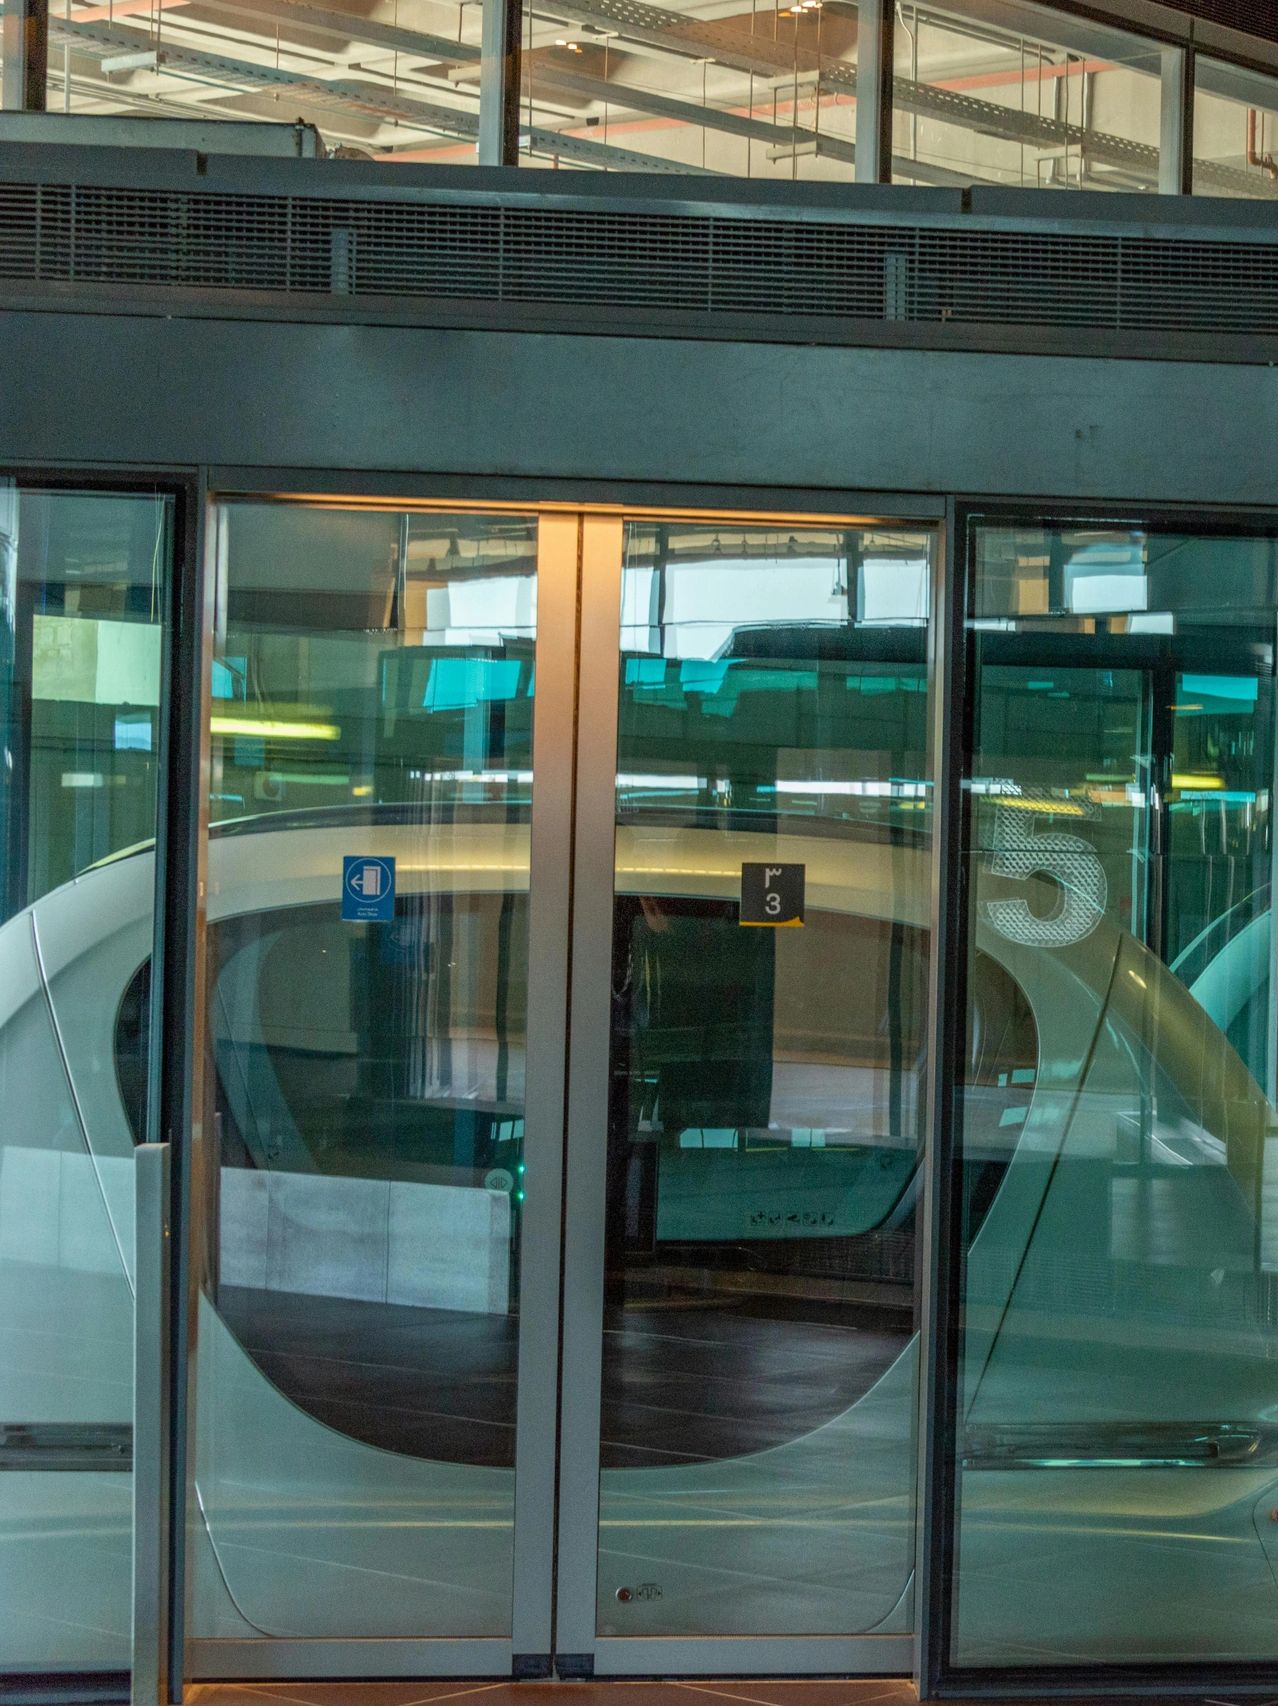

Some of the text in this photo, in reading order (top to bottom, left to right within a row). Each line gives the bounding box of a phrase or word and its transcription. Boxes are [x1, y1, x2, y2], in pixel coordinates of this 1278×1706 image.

[987, 781, 1107, 947] 5
[765, 867, 782, 889] ٣
[765, 892, 781, 915] 3
